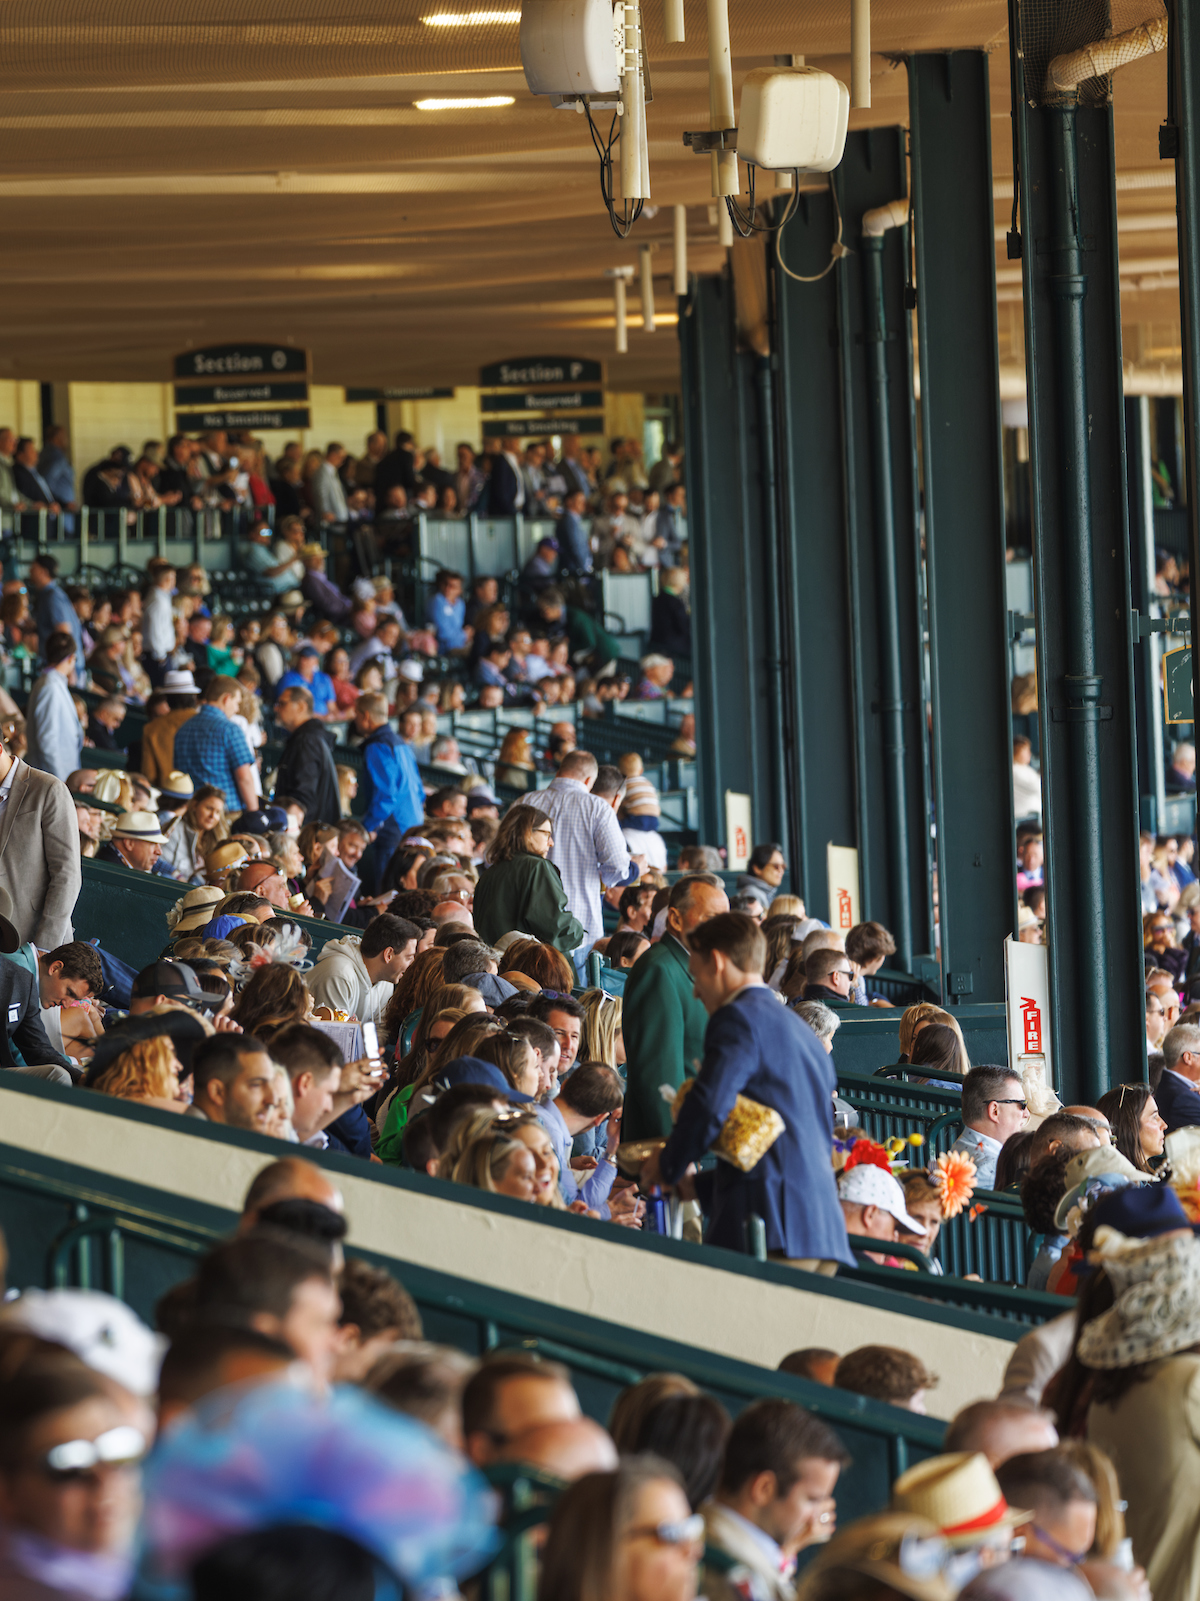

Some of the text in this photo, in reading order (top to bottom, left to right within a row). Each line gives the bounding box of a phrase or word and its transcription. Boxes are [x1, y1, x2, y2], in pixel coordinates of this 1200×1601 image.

[193, 352, 264, 373] Section
[500, 363, 564, 383] Section
[1026, 1011, 1039, 1050] FIRE
